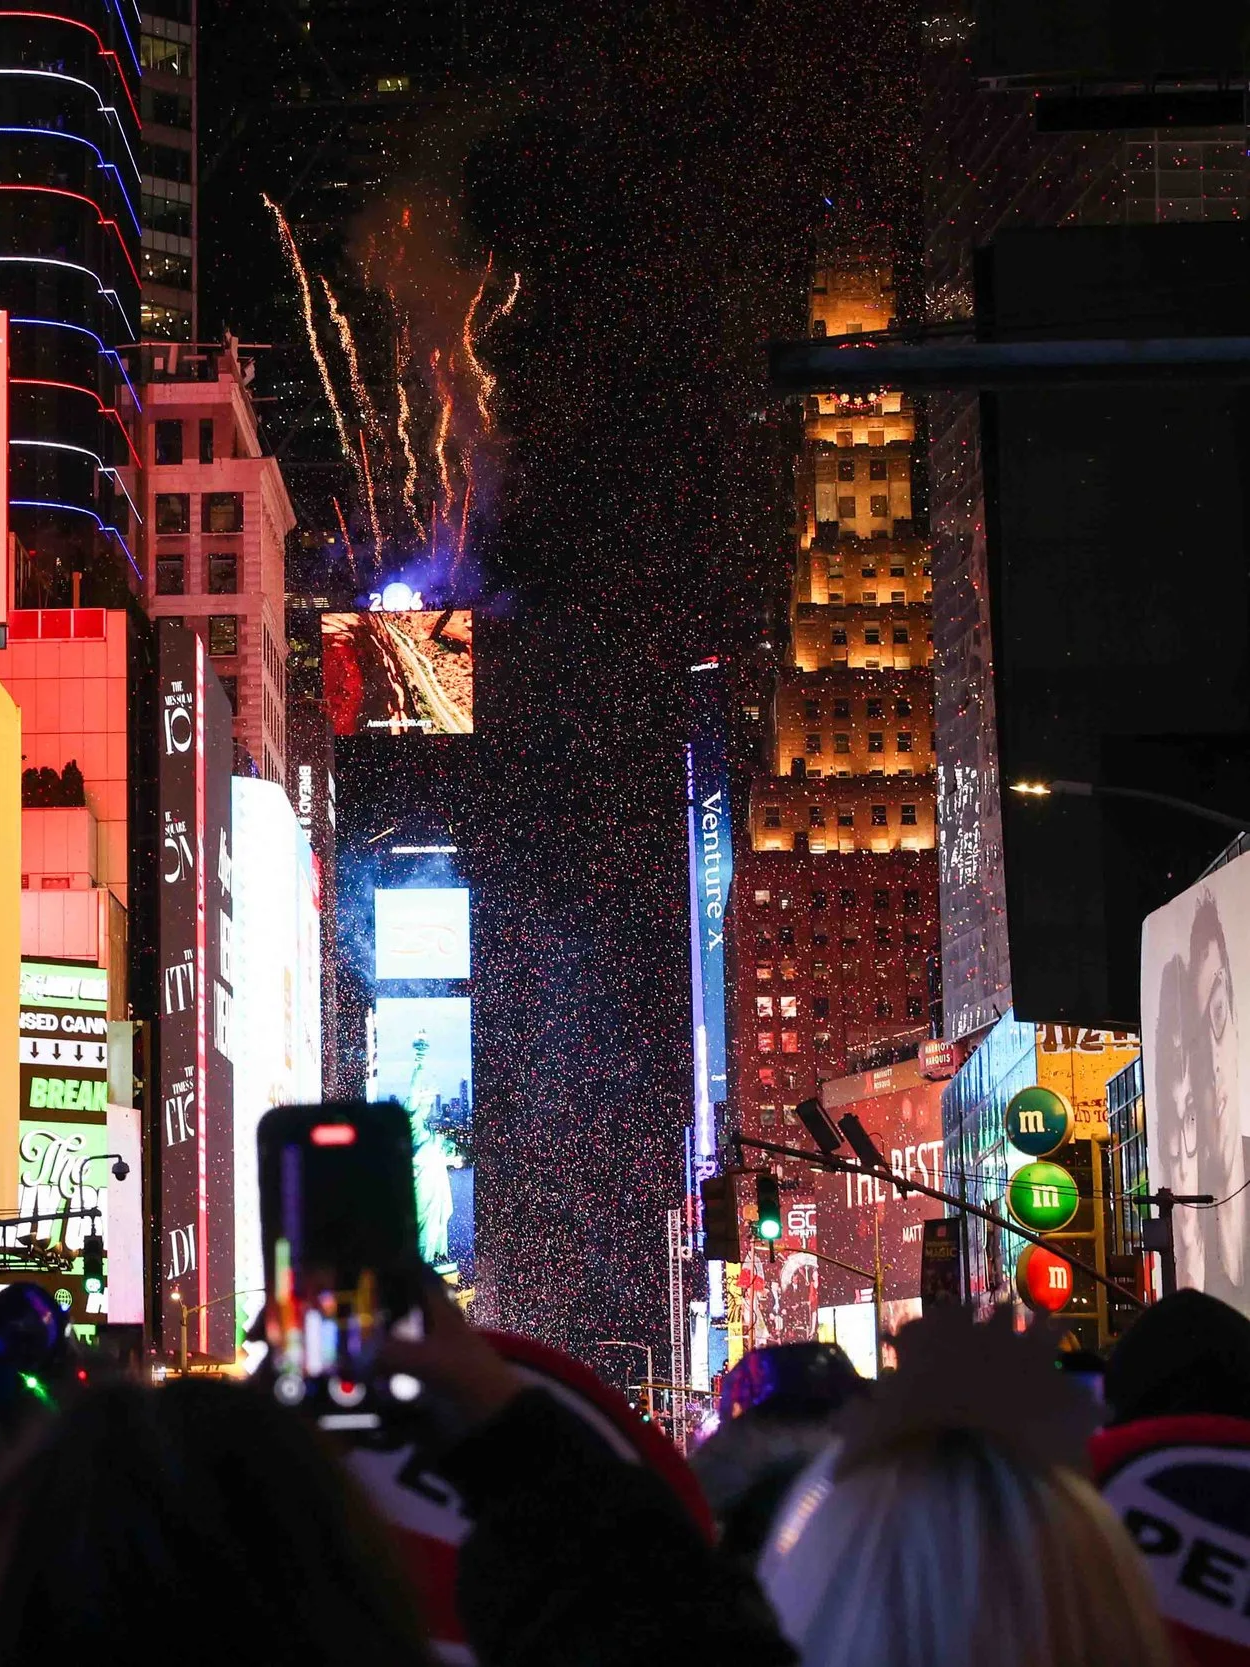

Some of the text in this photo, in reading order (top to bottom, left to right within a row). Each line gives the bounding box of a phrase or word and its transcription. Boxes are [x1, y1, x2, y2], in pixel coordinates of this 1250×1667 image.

[299, 765, 312, 813] BREAD
[701, 790, 724, 919] Venture
[1018, 1110, 1046, 1133] m
[20, 1129, 89, 1199] The
[845, 1140, 945, 1209] THE BEST
[1032, 1185, 1060, 1208] m
[902, 1224, 923, 1243] MATT
[1048, 1266, 1068, 1289] m
